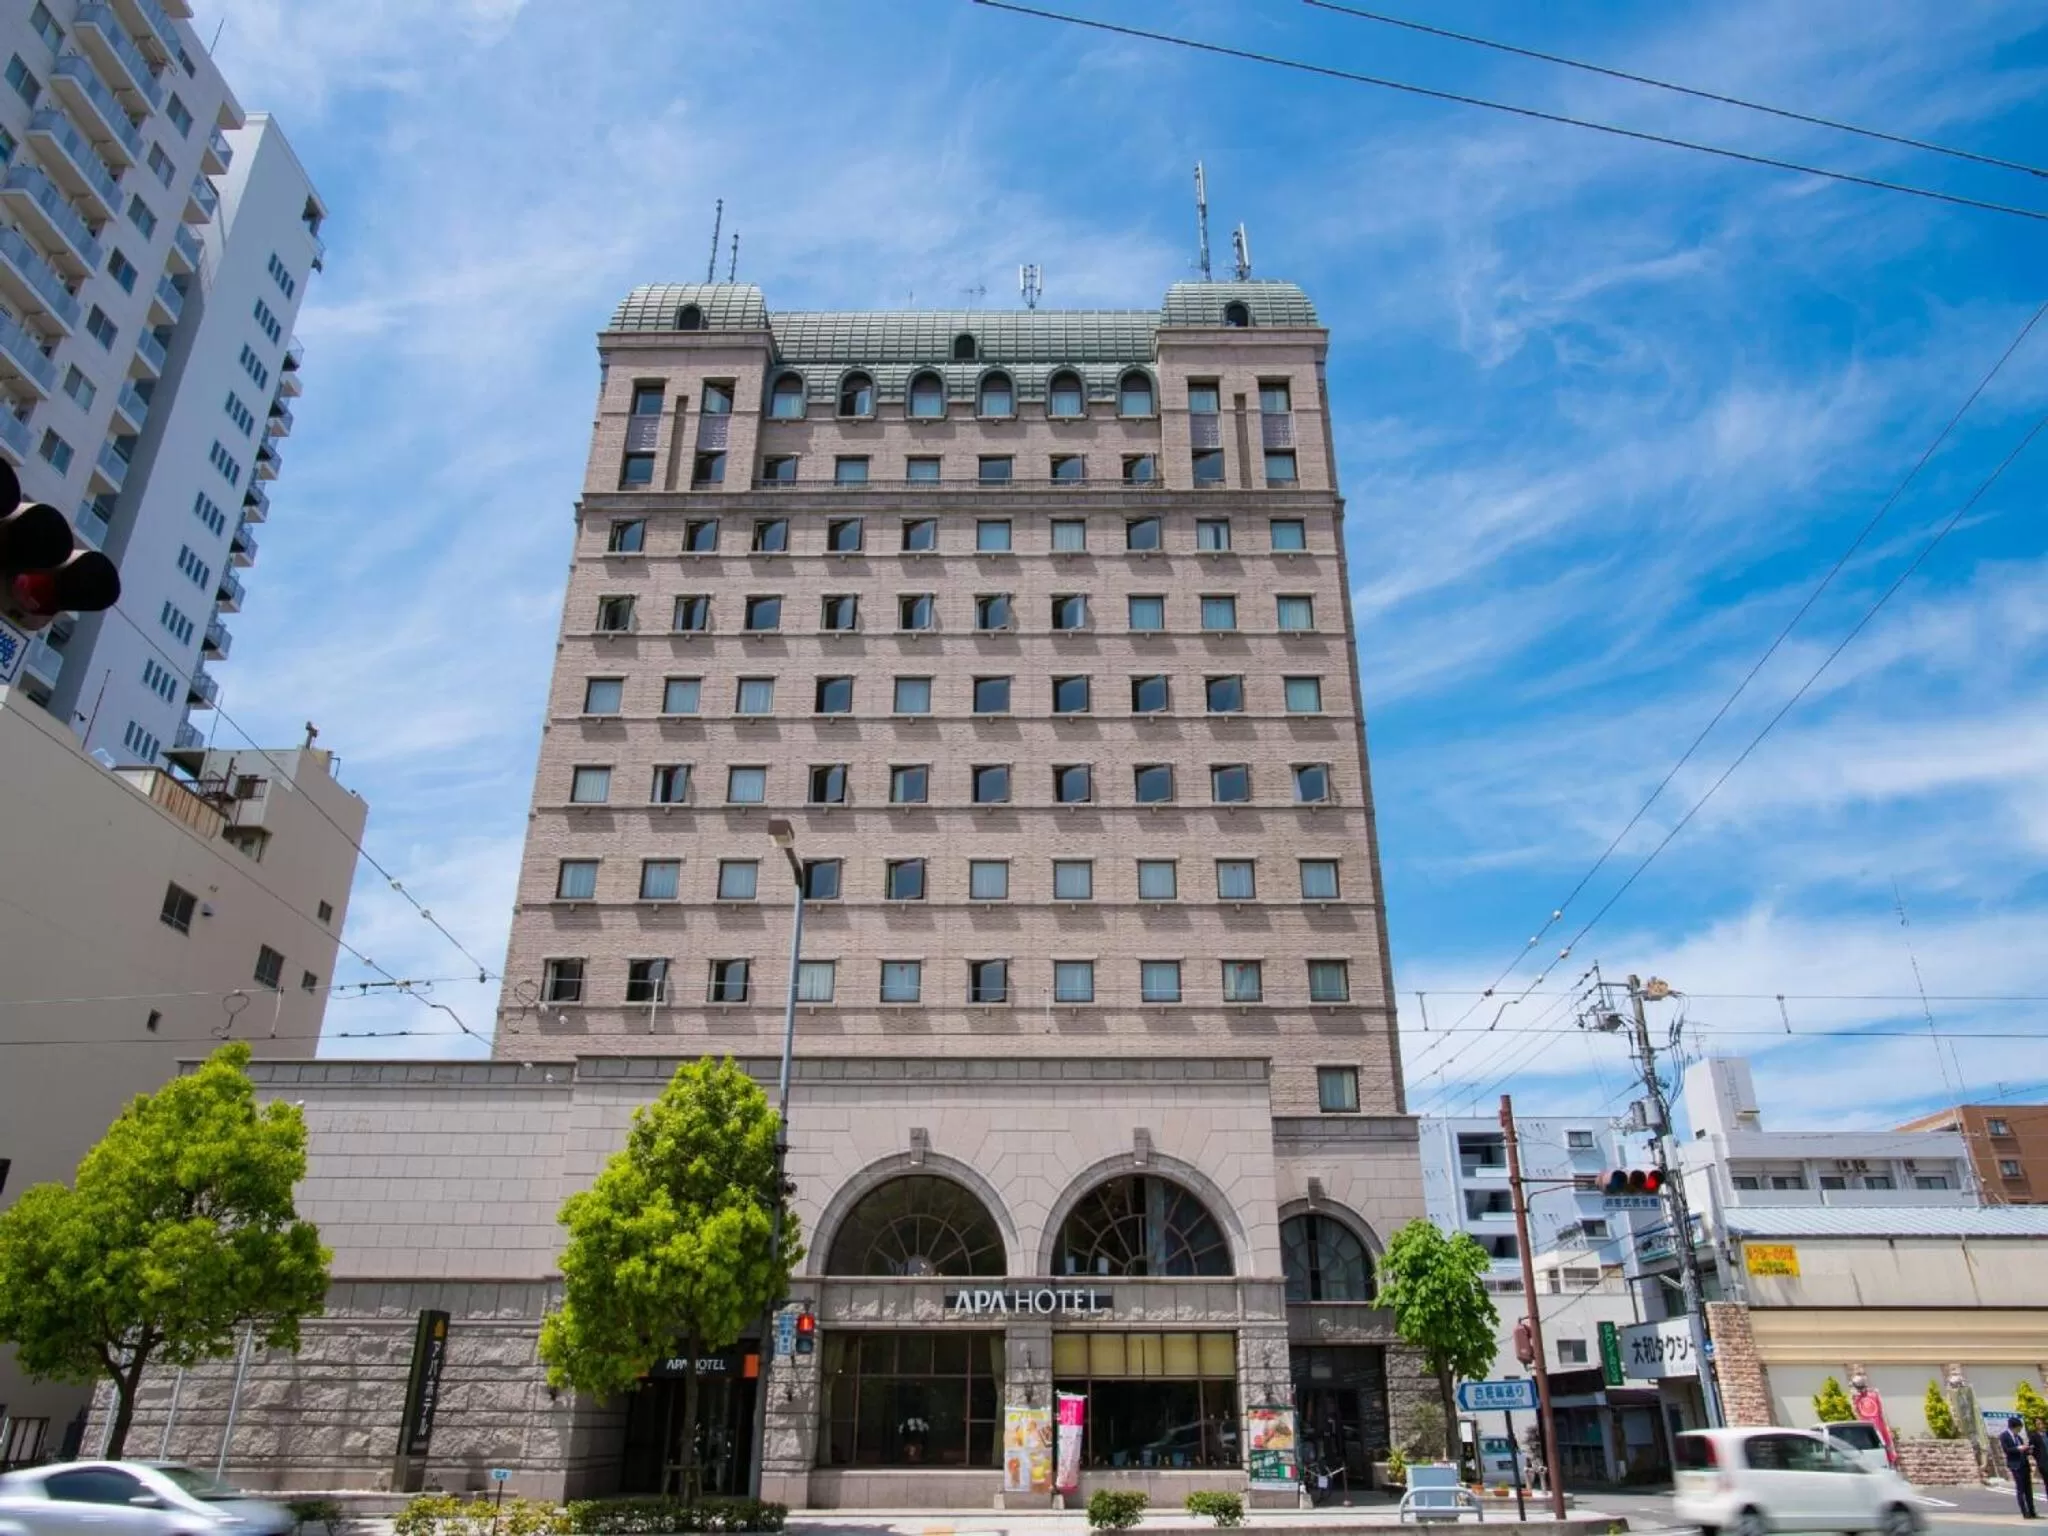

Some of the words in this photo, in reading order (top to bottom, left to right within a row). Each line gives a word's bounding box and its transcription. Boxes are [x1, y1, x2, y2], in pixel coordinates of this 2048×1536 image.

[955, 1290, 1008, 1314] APA
[1015, 1289, 1104, 1314] HOTEL
[417, 1341, 442, 1437] アパホテル
